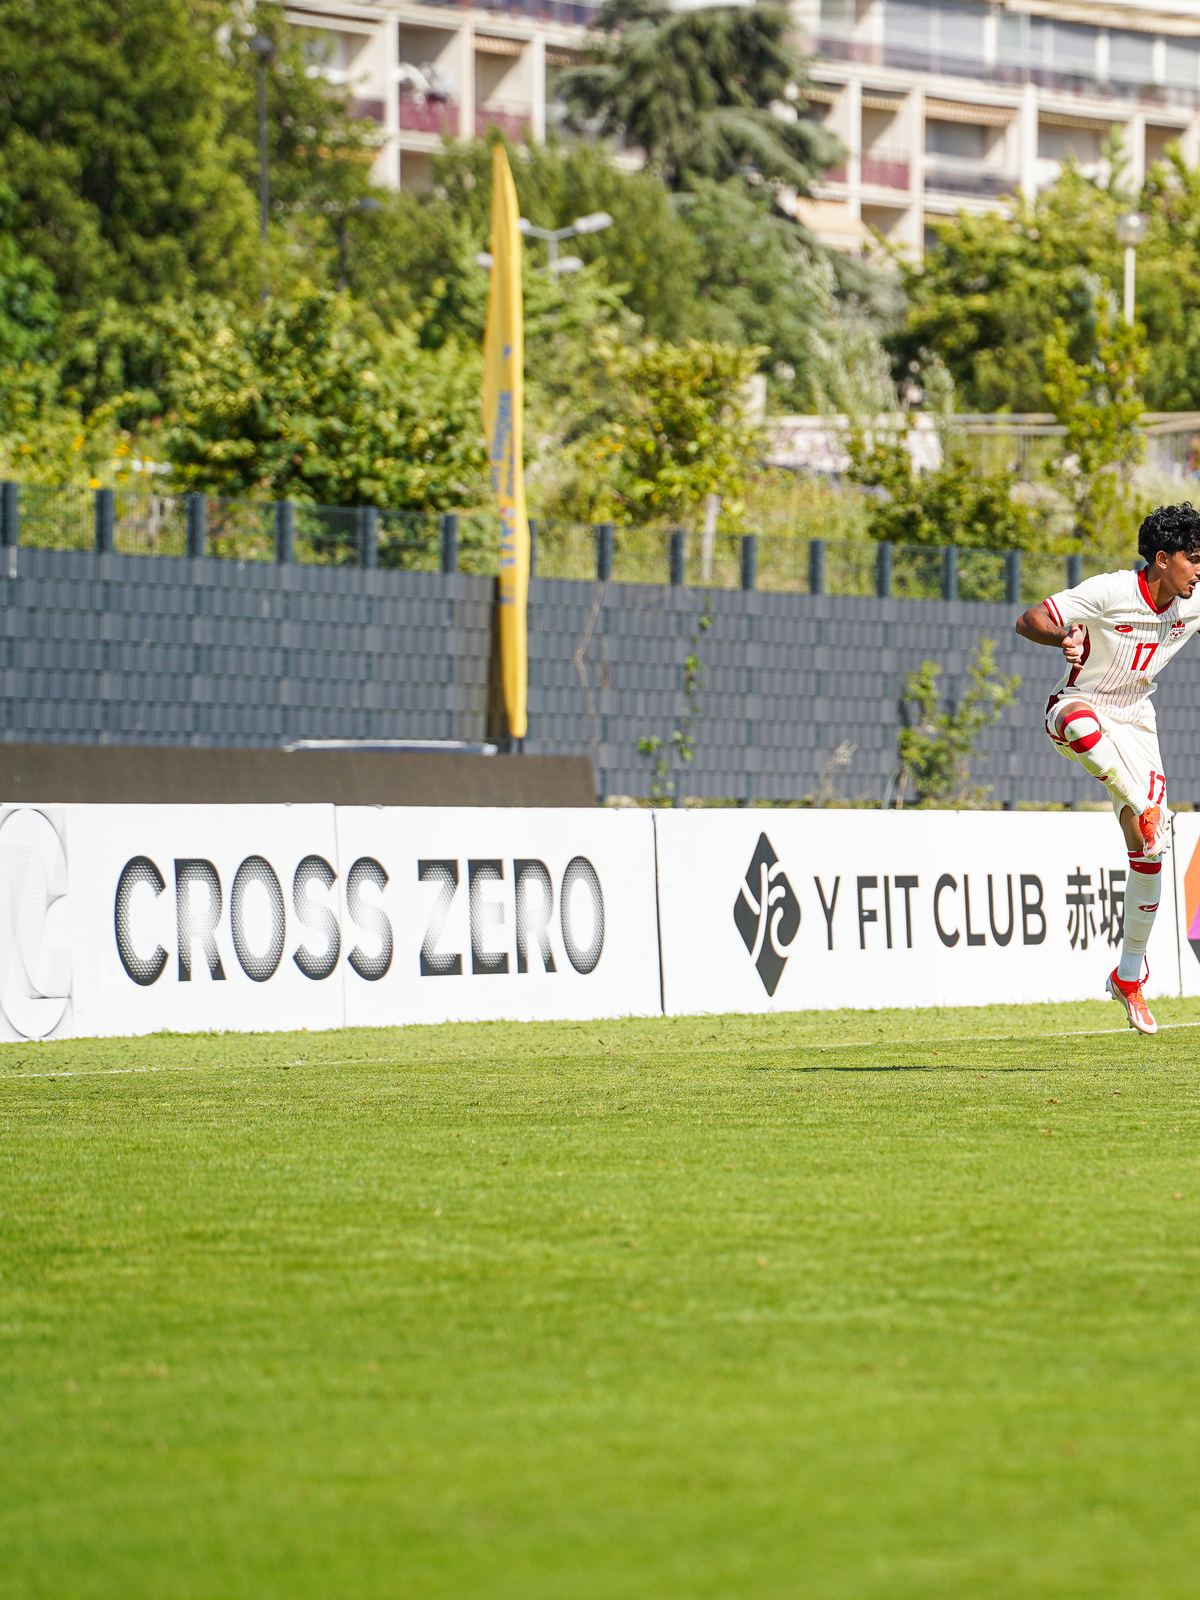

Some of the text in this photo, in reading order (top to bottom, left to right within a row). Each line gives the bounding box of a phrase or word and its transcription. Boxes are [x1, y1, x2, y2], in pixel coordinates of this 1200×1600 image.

[1131, 643, 1159, 671] 17
[1147, 770, 1166, 805] 17
[114, 854, 605, 986] CROSS ZERO
[813, 876, 841, 951] Y
[857, 874, 919, 950] FIT
[933, 873, 1047, 948] CLUB
